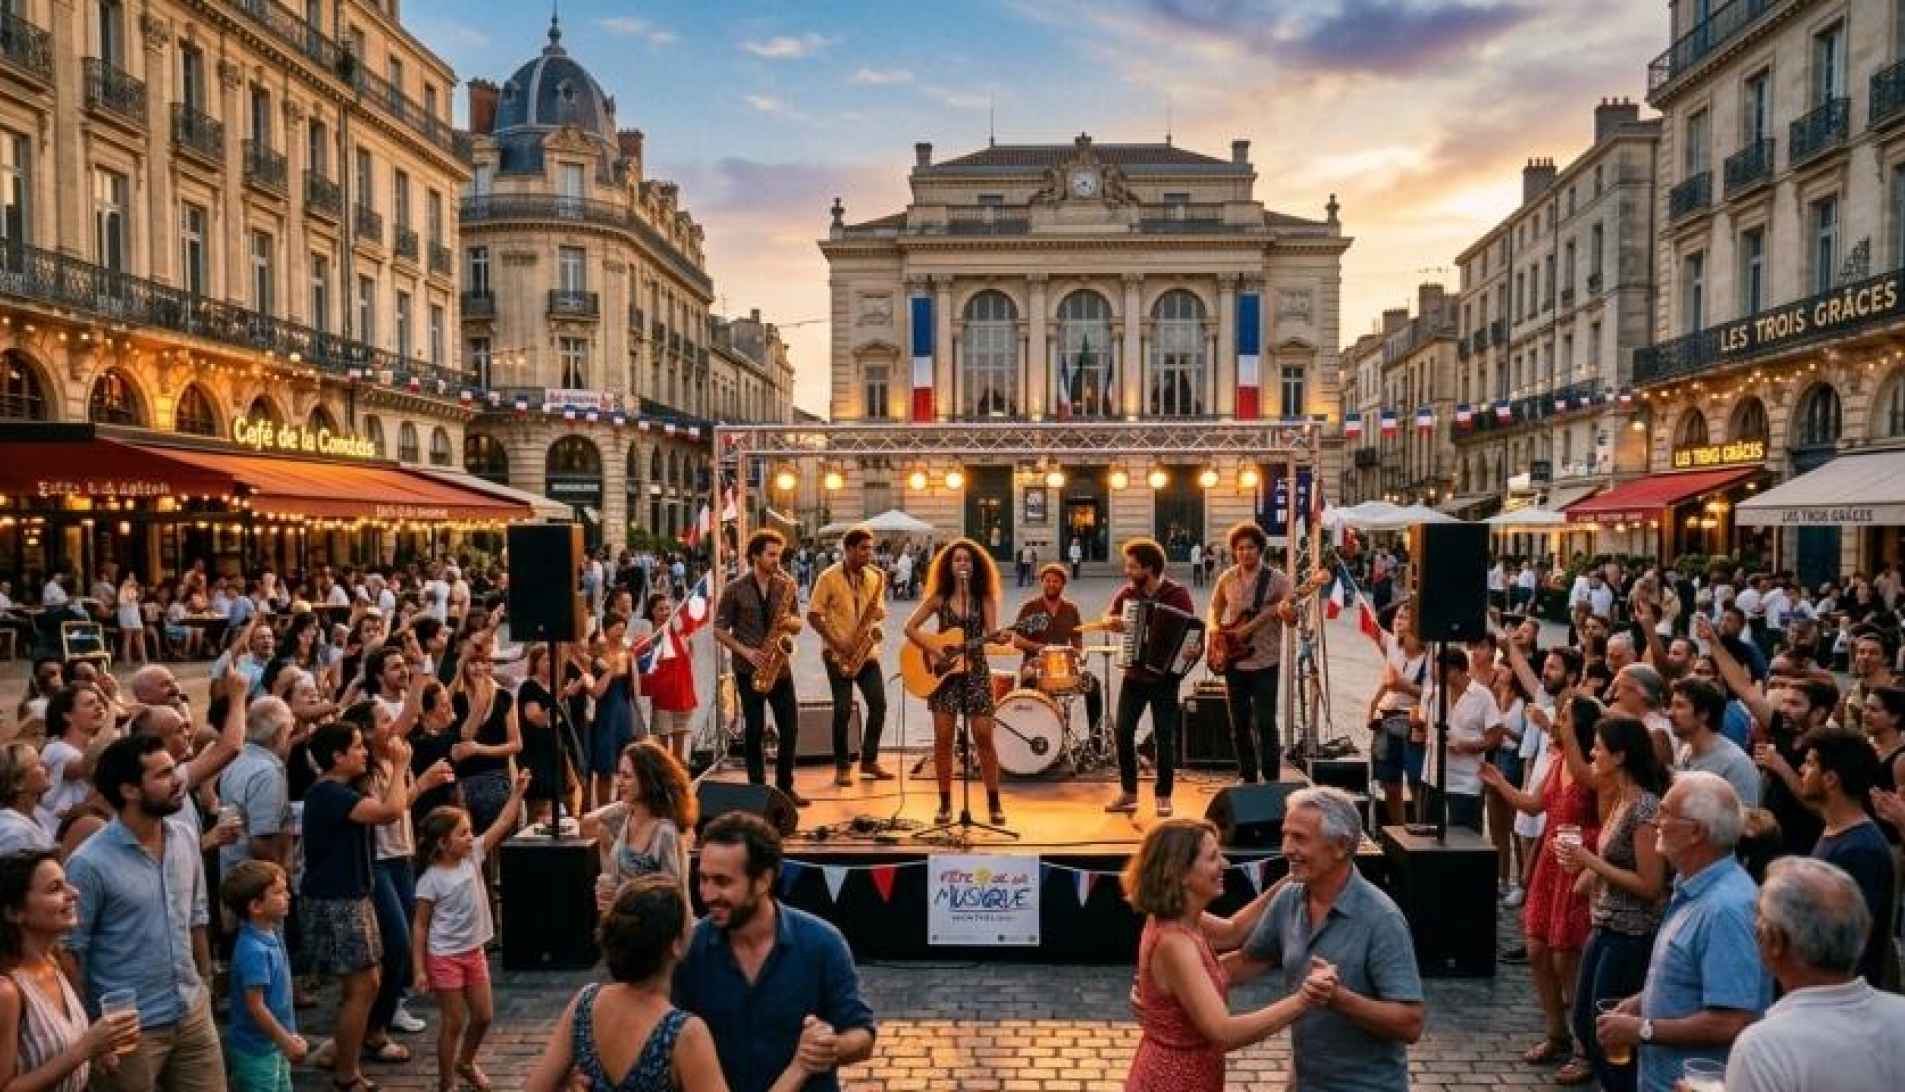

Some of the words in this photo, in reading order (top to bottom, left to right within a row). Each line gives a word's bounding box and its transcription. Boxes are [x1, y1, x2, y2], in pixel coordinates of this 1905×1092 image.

[1720, 325, 1747, 351] LES
[1754, 308, 1806, 343] TROIS
[279, 424, 298, 448] de
[302, 426, 315, 450] la
